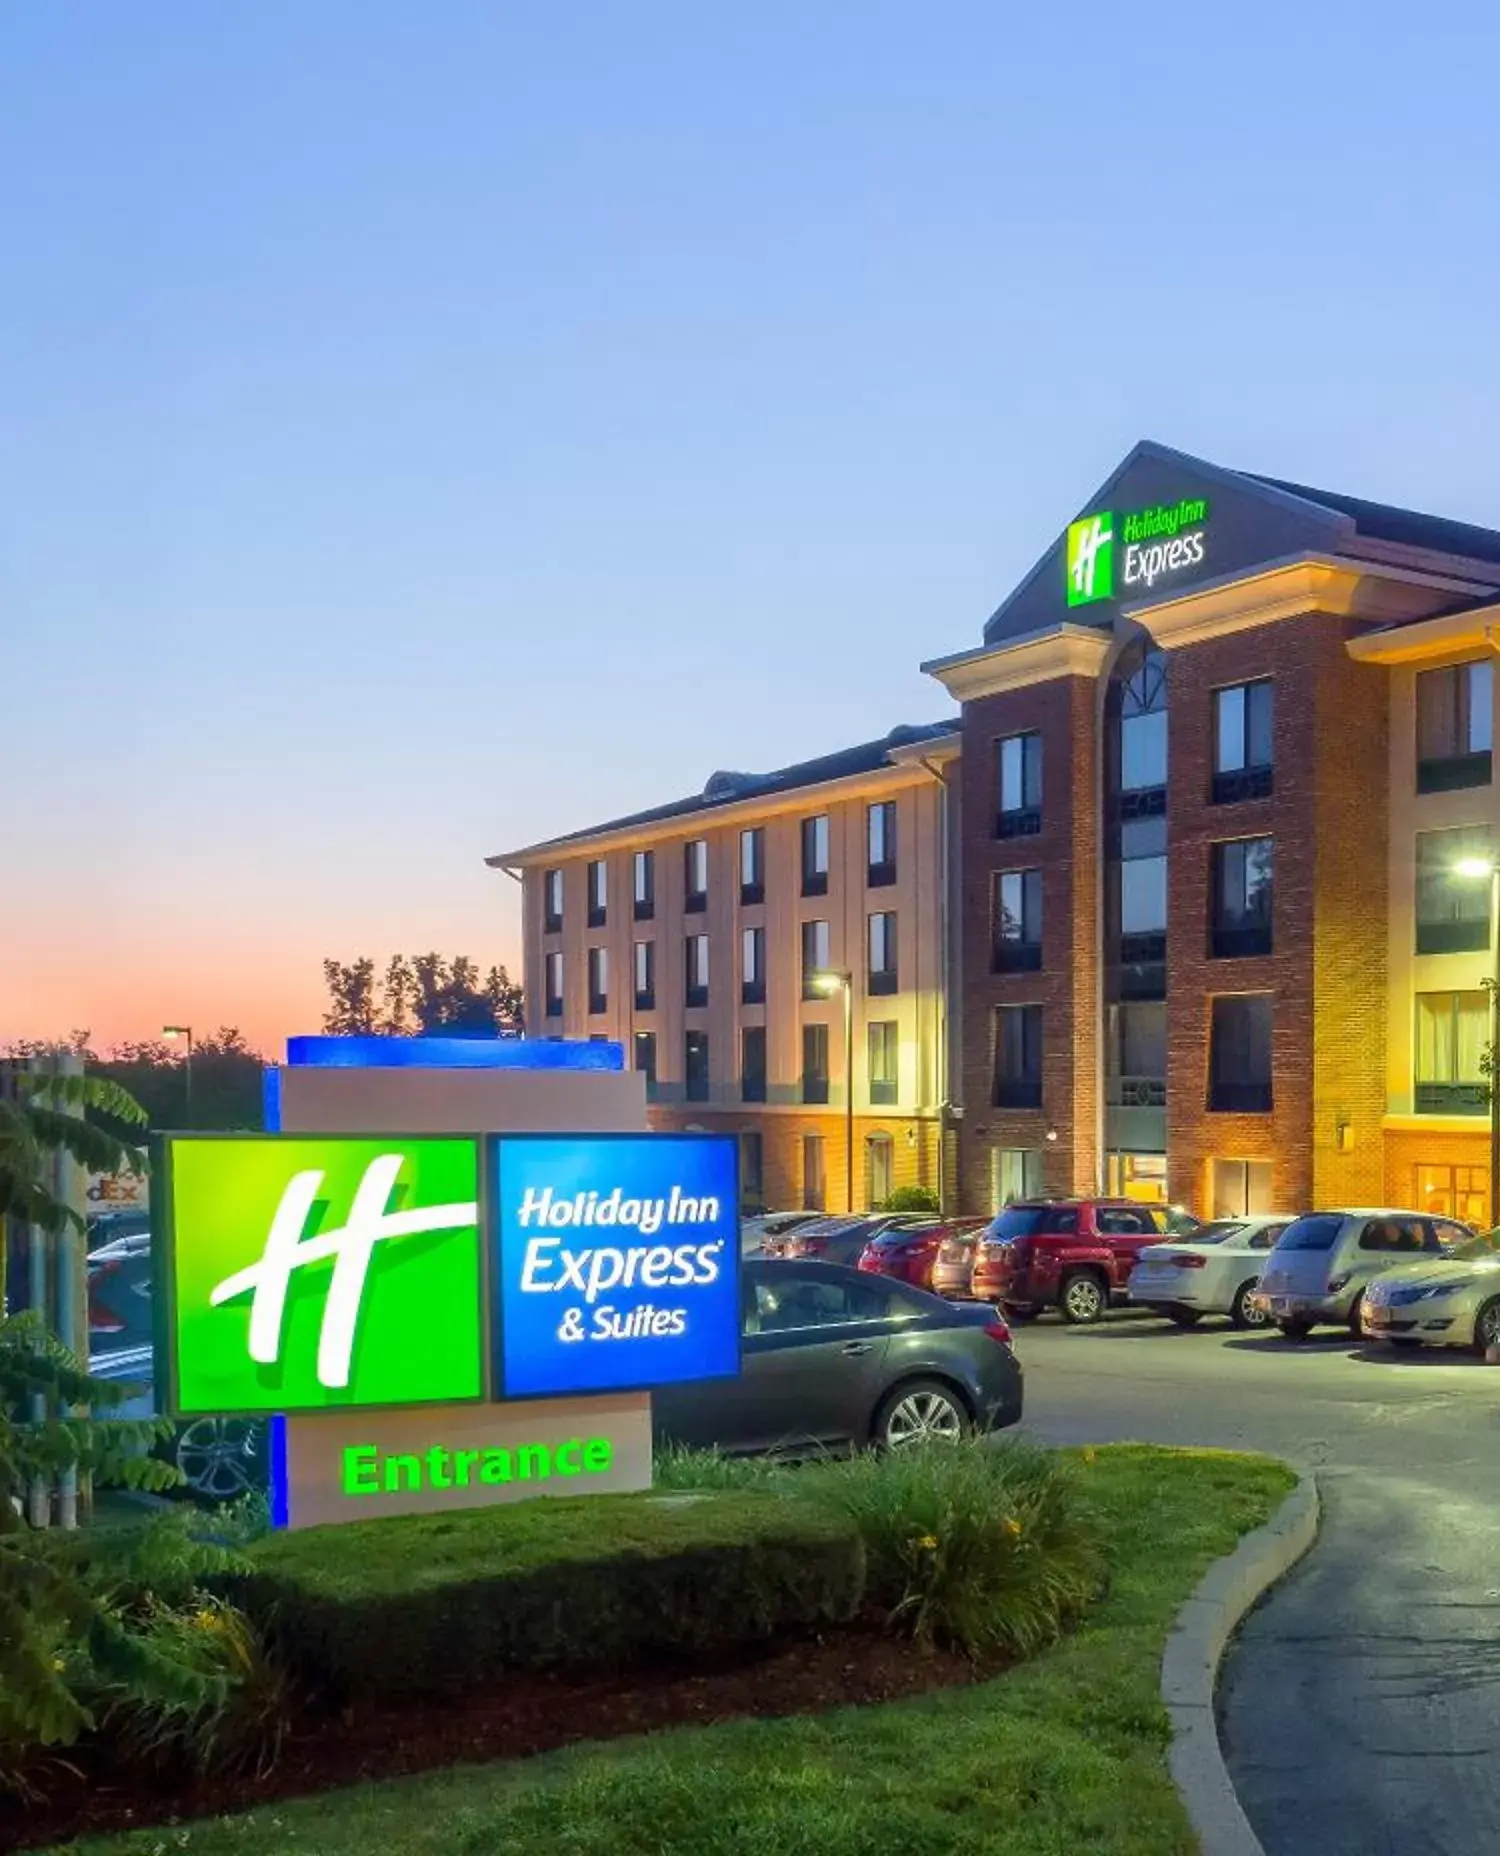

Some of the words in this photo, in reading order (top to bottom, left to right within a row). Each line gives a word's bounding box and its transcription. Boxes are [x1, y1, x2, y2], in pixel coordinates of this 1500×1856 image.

[1123, 508, 1179, 543] Holiday
[1179, 500, 1206, 525] Inn
[1124, 532, 1204, 587] Express
[518, 1186, 665, 1233] Holiday
[667, 1185, 719, 1224] Inn
[520, 1236, 720, 1304] Express
[557, 1306, 585, 1343] &
[590, 1304, 687, 1341] Suites
[343, 1437, 612, 1494] Entrance
